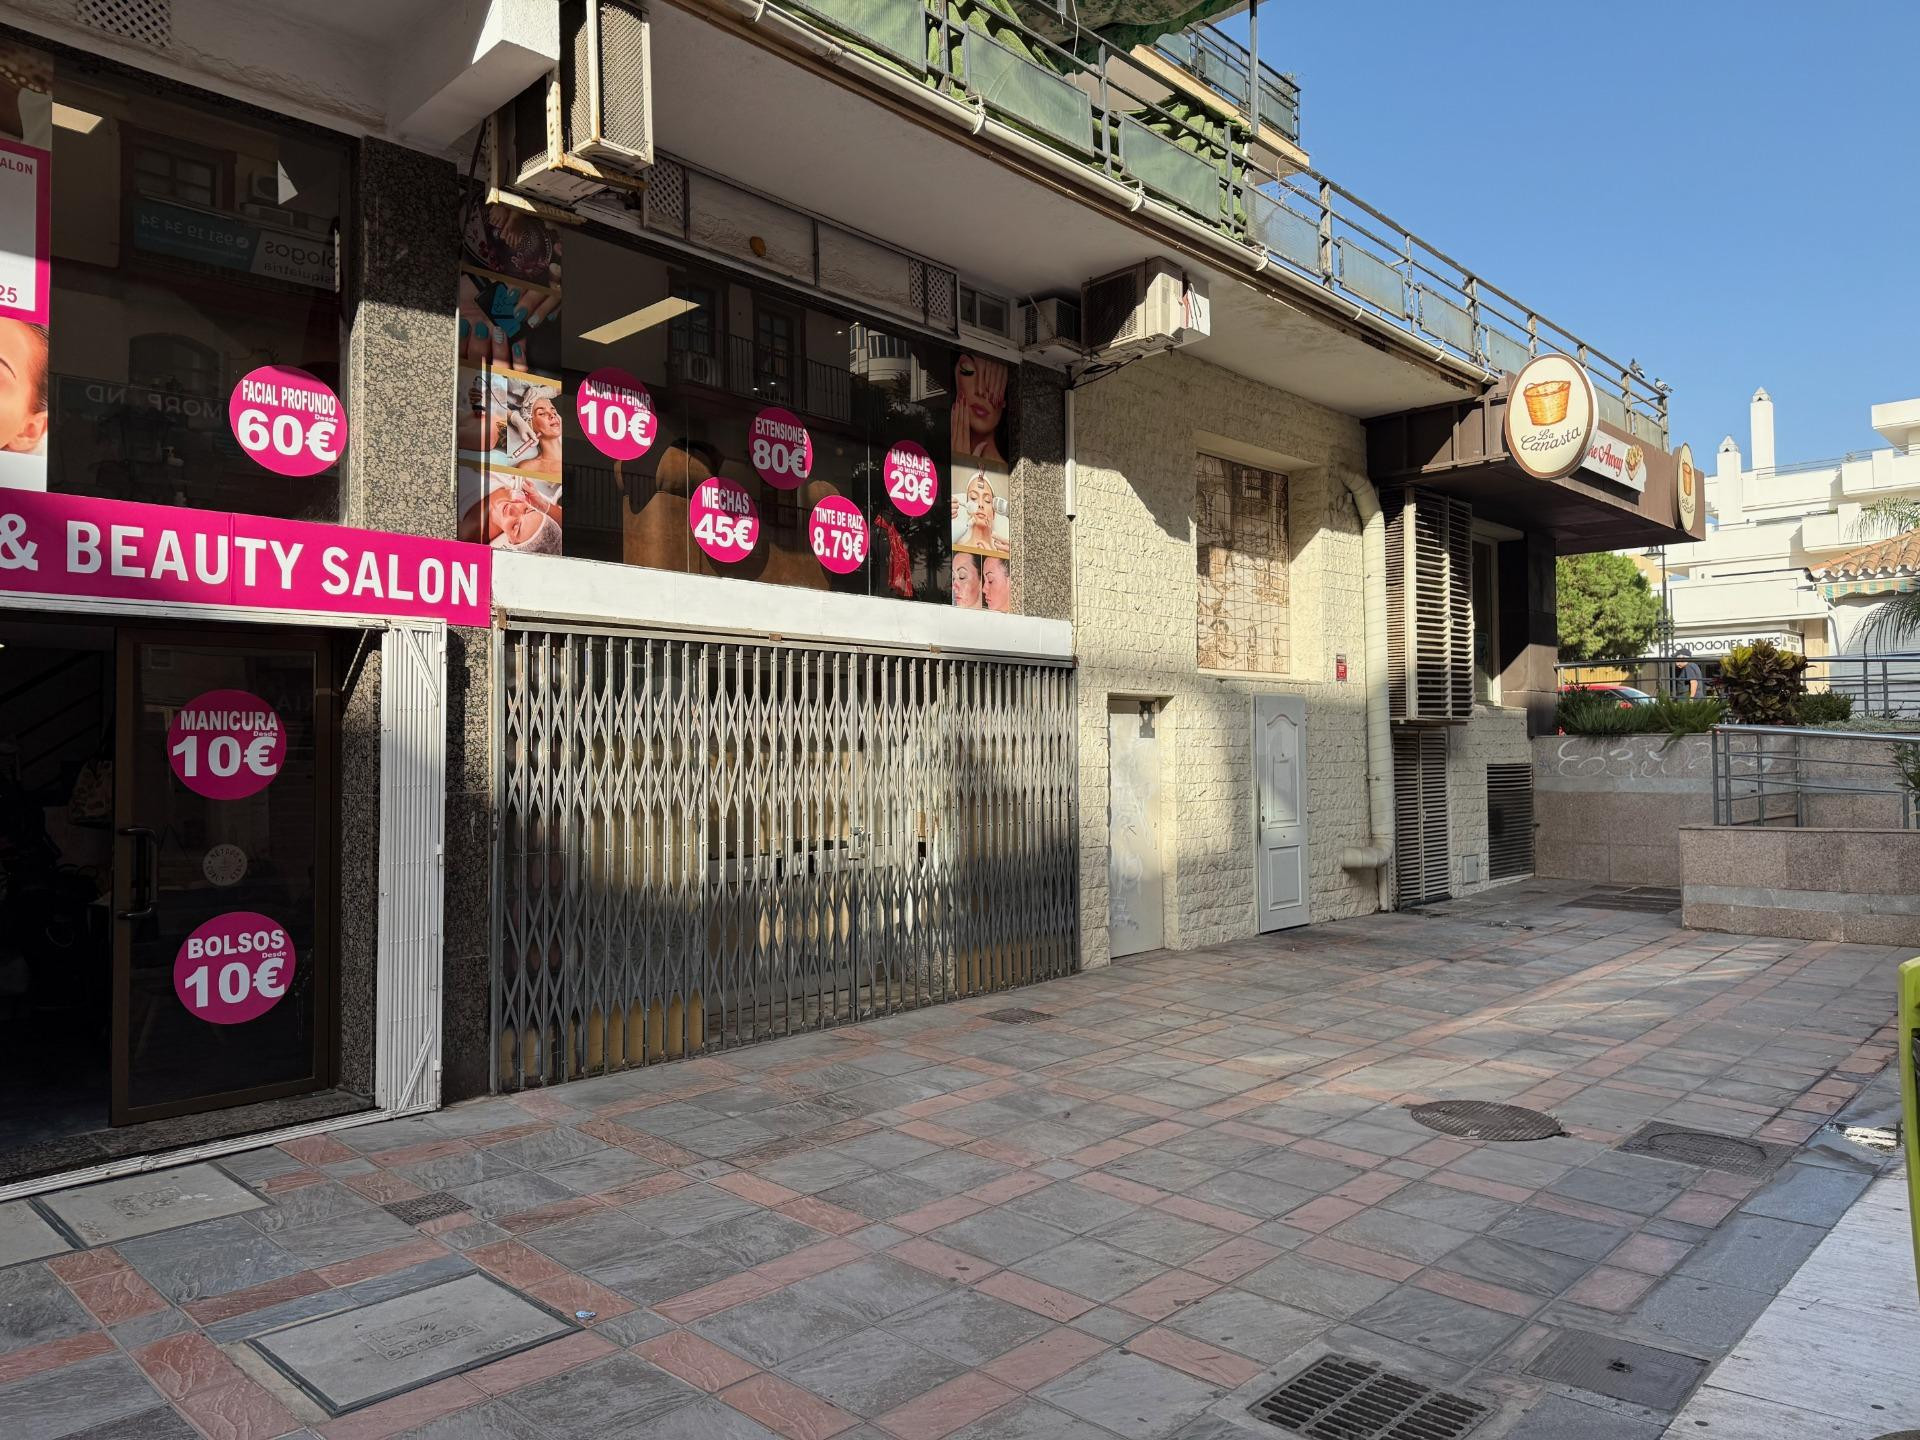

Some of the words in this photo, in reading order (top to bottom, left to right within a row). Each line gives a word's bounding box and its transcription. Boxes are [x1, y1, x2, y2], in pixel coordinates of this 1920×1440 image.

[242, 379, 279, 406] FACIAL
[281, 386, 336, 416] PROFUNDO
[585, 378, 612, 401] LAVAR
[614, 385, 619, 401] Y
[622, 387, 651, 410] PEINAR
[314, 414, 338, 424] Desde
[580, 400, 651, 446] 10€
[755, 417, 807, 445] EXTENSIONES
[238, 409, 337, 462] 60€
[1520, 427, 1582, 452] Canasta
[1538, 429, 1554, 441] La
[753, 439, 807, 479] 80€
[891, 448, 931, 472] MASAJE
[904, 467, 929, 478] MINUTOS
[702, 485, 750, 514] MECHAS
[890, 470, 933, 506] 29€
[695, 513, 754, 551] 45€
[815, 507, 836, 525] TINTE
[837, 511, 846, 527] DE
[848, 513, 863, 530] RAIZ
[0, 512, 38, 571] &
[66, 520, 304, 591] BEAUTY
[322, 546, 479, 608] SALON
[814, 526, 864, 563] 8.79€
[180, 710, 278, 731] MANICURA
[173, 736, 277, 777] 10€
[188, 929, 285, 959] BOLSOS
[262, 950, 286, 959] Desde
[185, 957, 285, 1008] 10€
